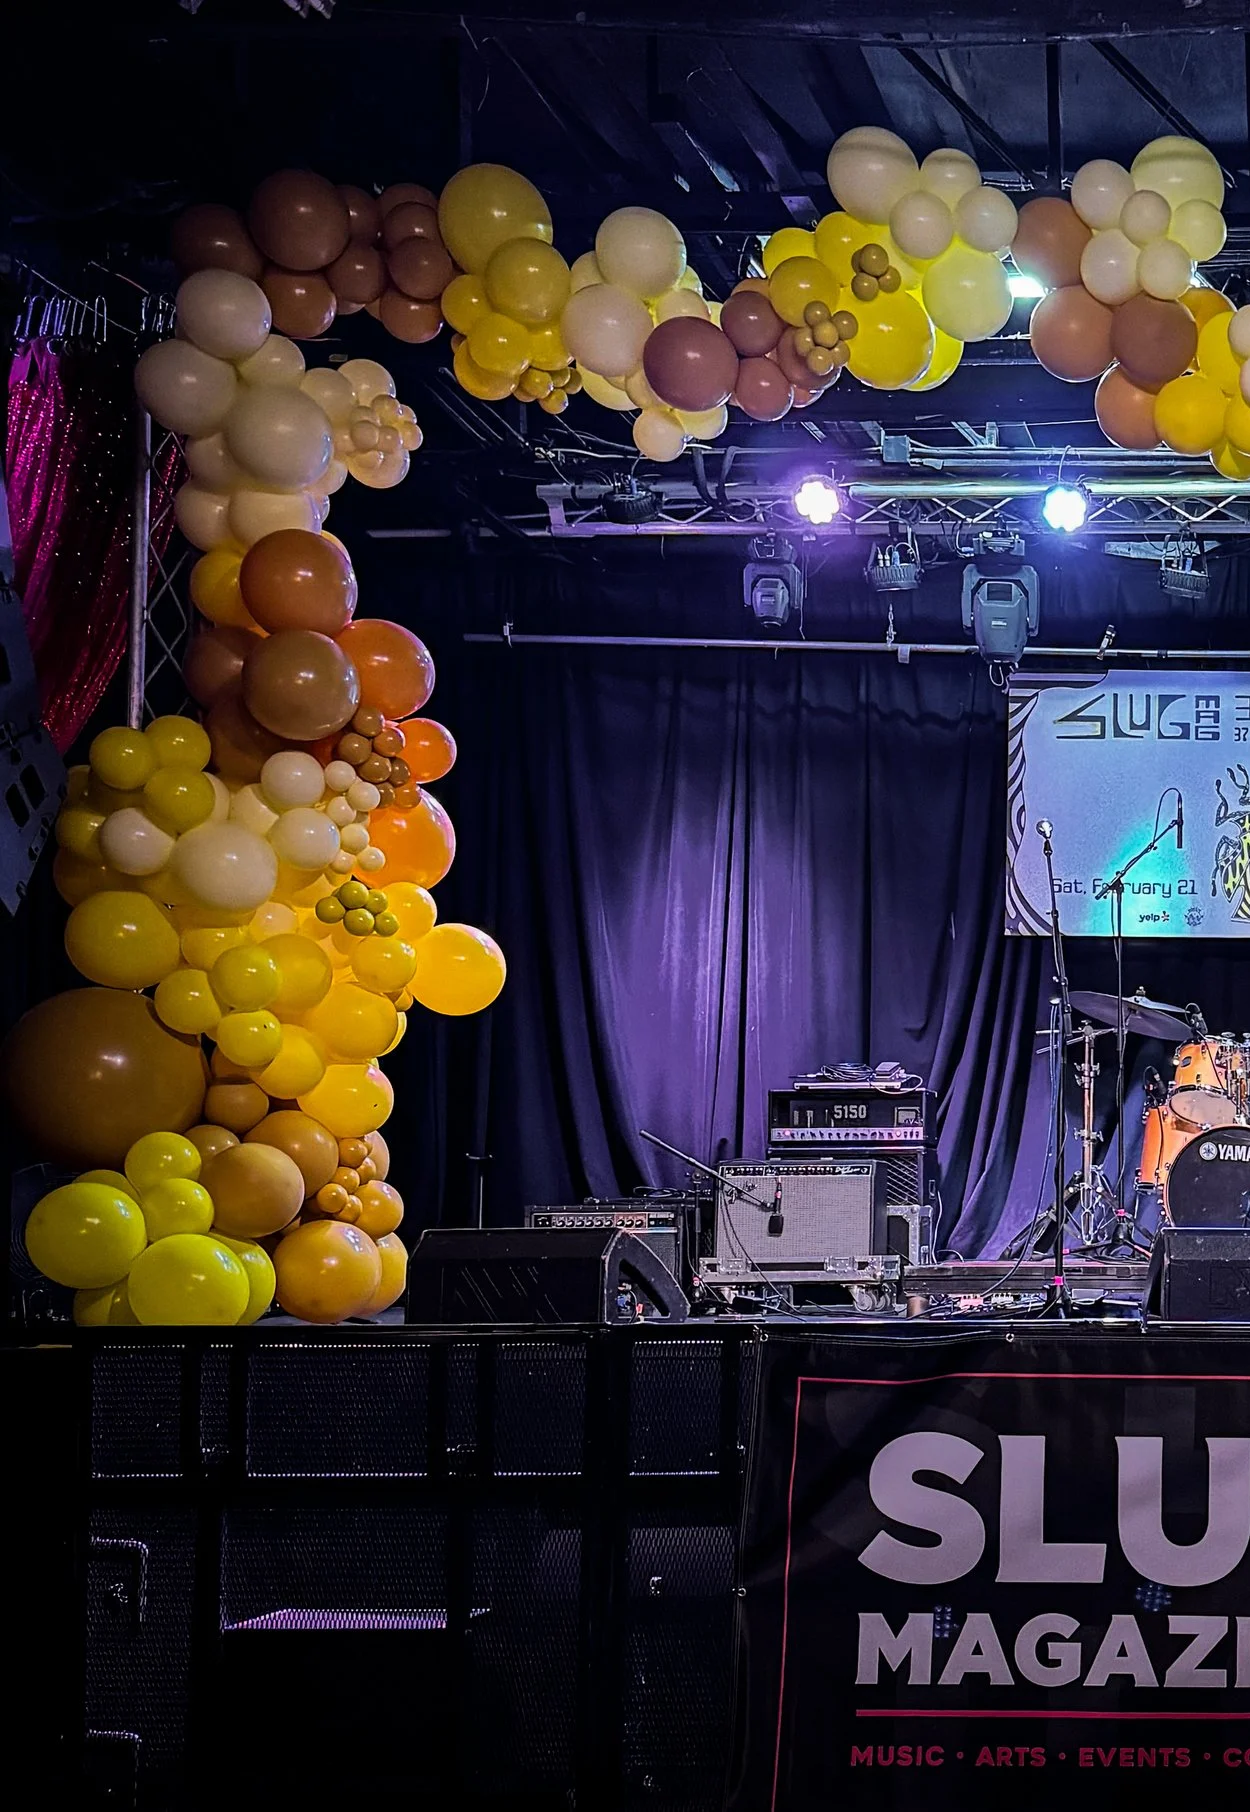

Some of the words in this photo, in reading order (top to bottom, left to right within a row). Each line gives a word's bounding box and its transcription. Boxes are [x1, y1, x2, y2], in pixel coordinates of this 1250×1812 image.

[1053, 693, 1190, 740] SLUG
[1194, 695, 1221, 741] MAG
[1234, 727, 1249, 742] 37
[1052, 878, 1087, 895] Sat,
[1177, 880, 1199, 895] 21
[1139, 913, 1161, 923] yelp
[833, 1104, 867, 1119] 5150
[850, 1745, 946, 1767] MUSIC
[975, 1746, 1046, 1767] ARTS
[1078, 1746, 1191, 1768] EVENTS
